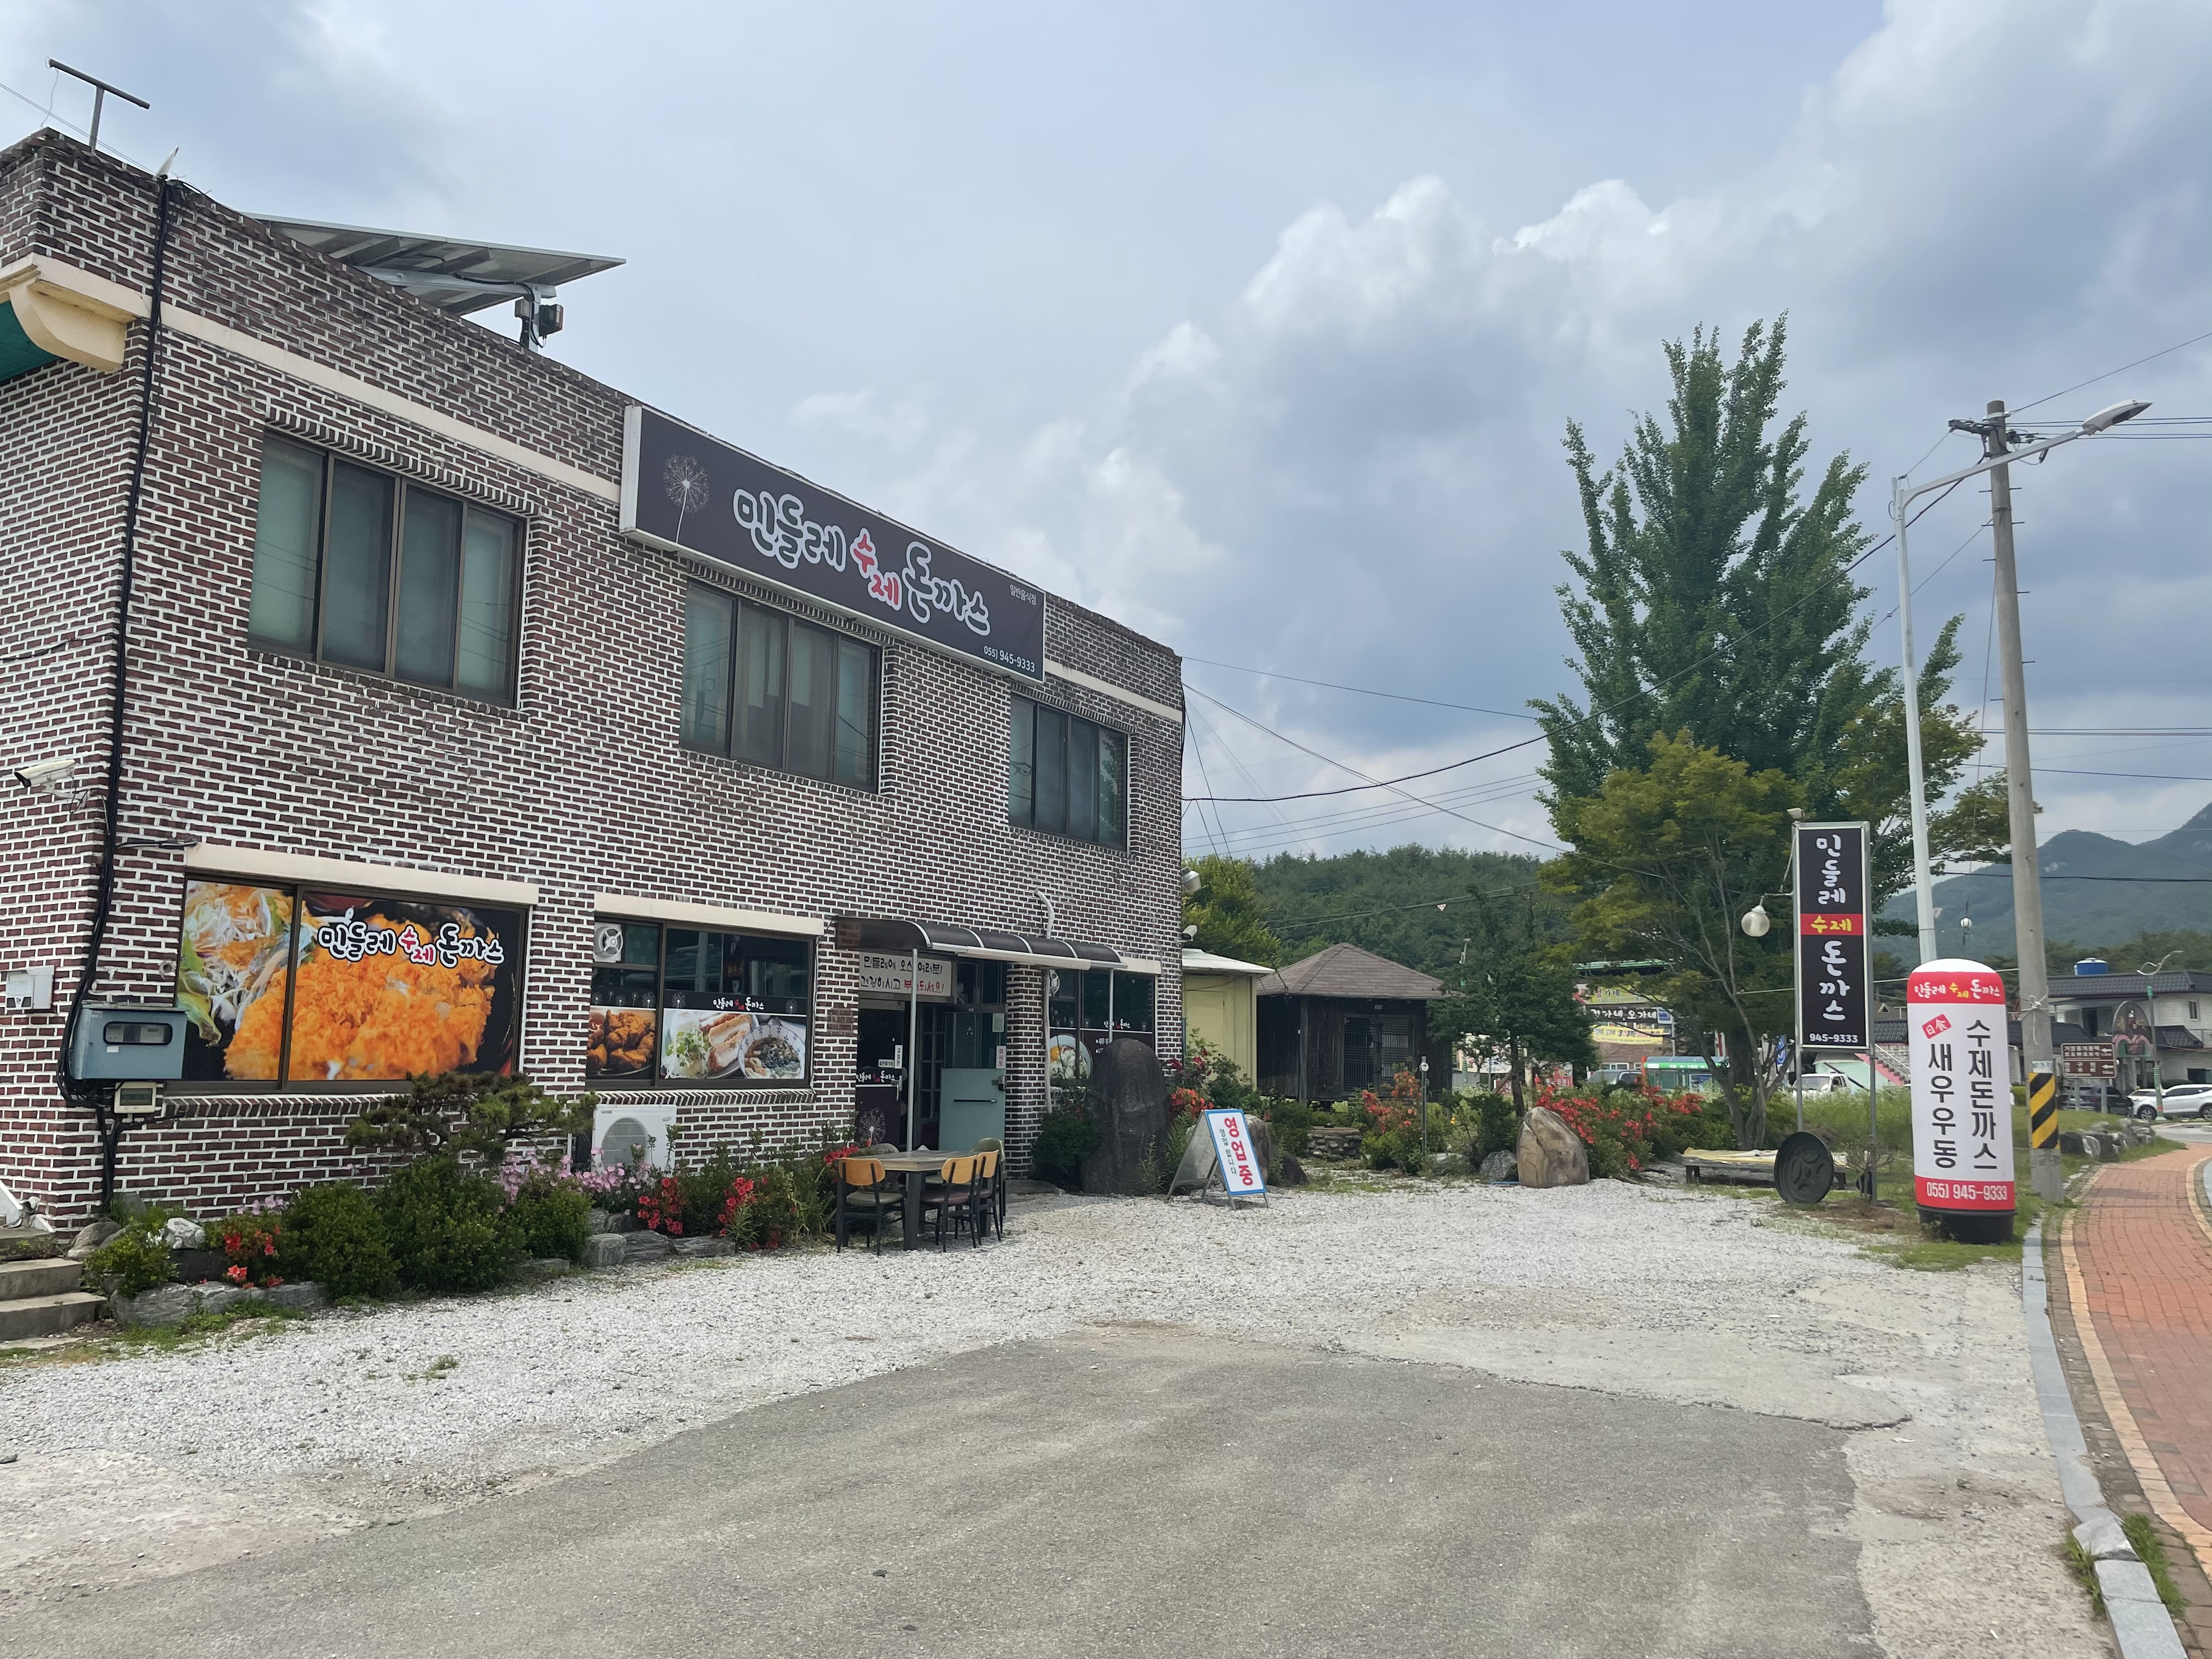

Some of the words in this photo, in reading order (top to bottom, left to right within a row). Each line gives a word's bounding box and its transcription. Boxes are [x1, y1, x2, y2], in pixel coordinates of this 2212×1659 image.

[733, 488, 847, 572] 민들레
[850, 528, 902, 611] 수제
[902, 540, 990, 636] 돈까스
[1009, 583, 1037, 606] 일반음식점
[984, 645, 998, 662] 055)
[1000, 648, 1035, 673] 945-9333
[1816, 834, 1846, 905] 민들레
[1810, 914, 1852, 934] 수제
[318, 921, 396, 963] 민들레
[398, 923, 437, 966] 수제
[437, 922, 505, 968] 돈까스
[864, 956, 896, 970] 민들레에
[918, 961, 943, 975] 여러분!
[861, 975, 901, 990] 건강하시고
[904, 979, 944, 993] 부되세요!
[1819, 940, 1851, 1021] 돈까스
[1914, 981, 1946, 998] 민들레
[1949, 982, 1969, 998] 수제
[1970, 979, 2001, 1000] 돈까스
[713, 997, 733, 1009] 민들레
[745, 996, 764, 1011] 돈까스
[1809, 1032, 1859, 1044] 945-9333
[1966, 1019, 1998, 1170] 수제돈까스
[1224, 1117, 1253, 1186] 영업중
[1953, 1183, 2008, 1201] 945-9333
